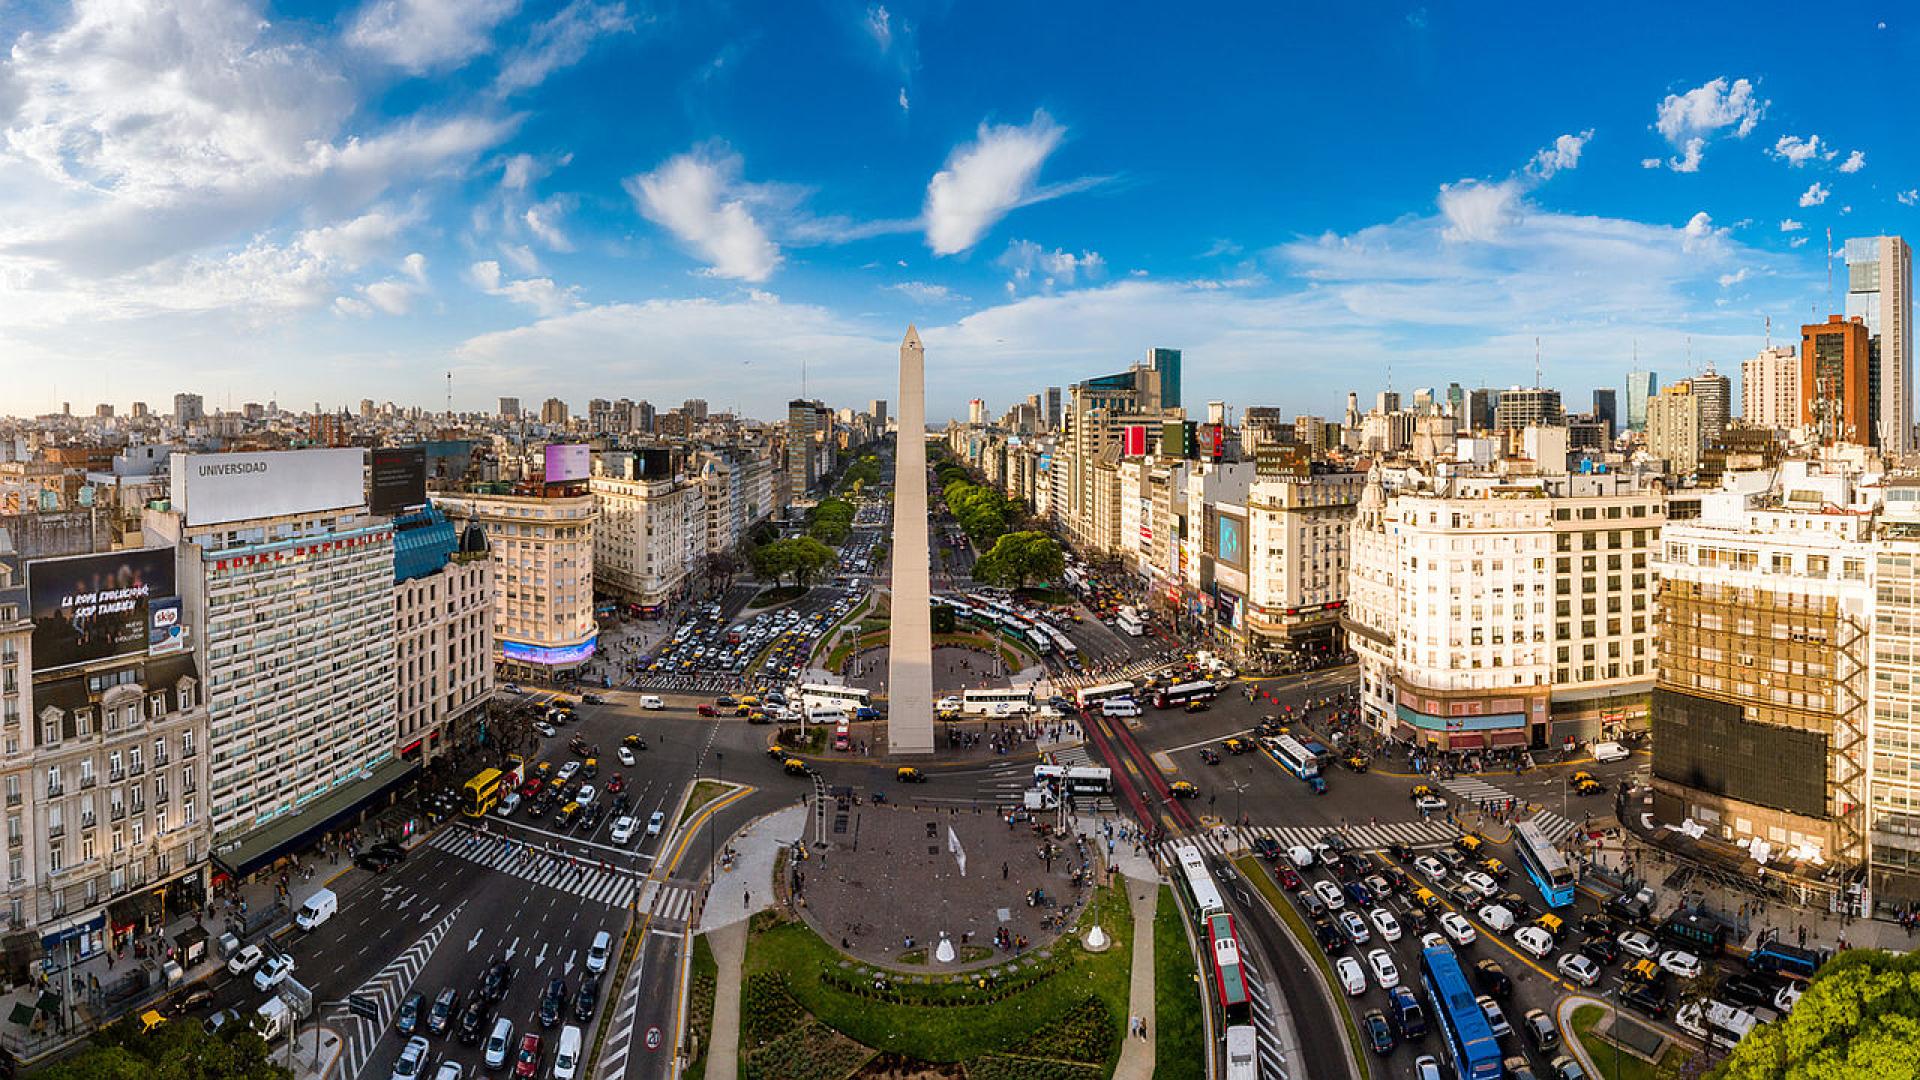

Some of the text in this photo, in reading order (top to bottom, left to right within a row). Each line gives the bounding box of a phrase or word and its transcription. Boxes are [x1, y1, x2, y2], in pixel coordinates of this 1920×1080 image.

[199, 461, 267, 477] UNIVERSIDAD
[215, 551, 284, 572] HOTEL
[648, 1031, 659, 1044] 20
